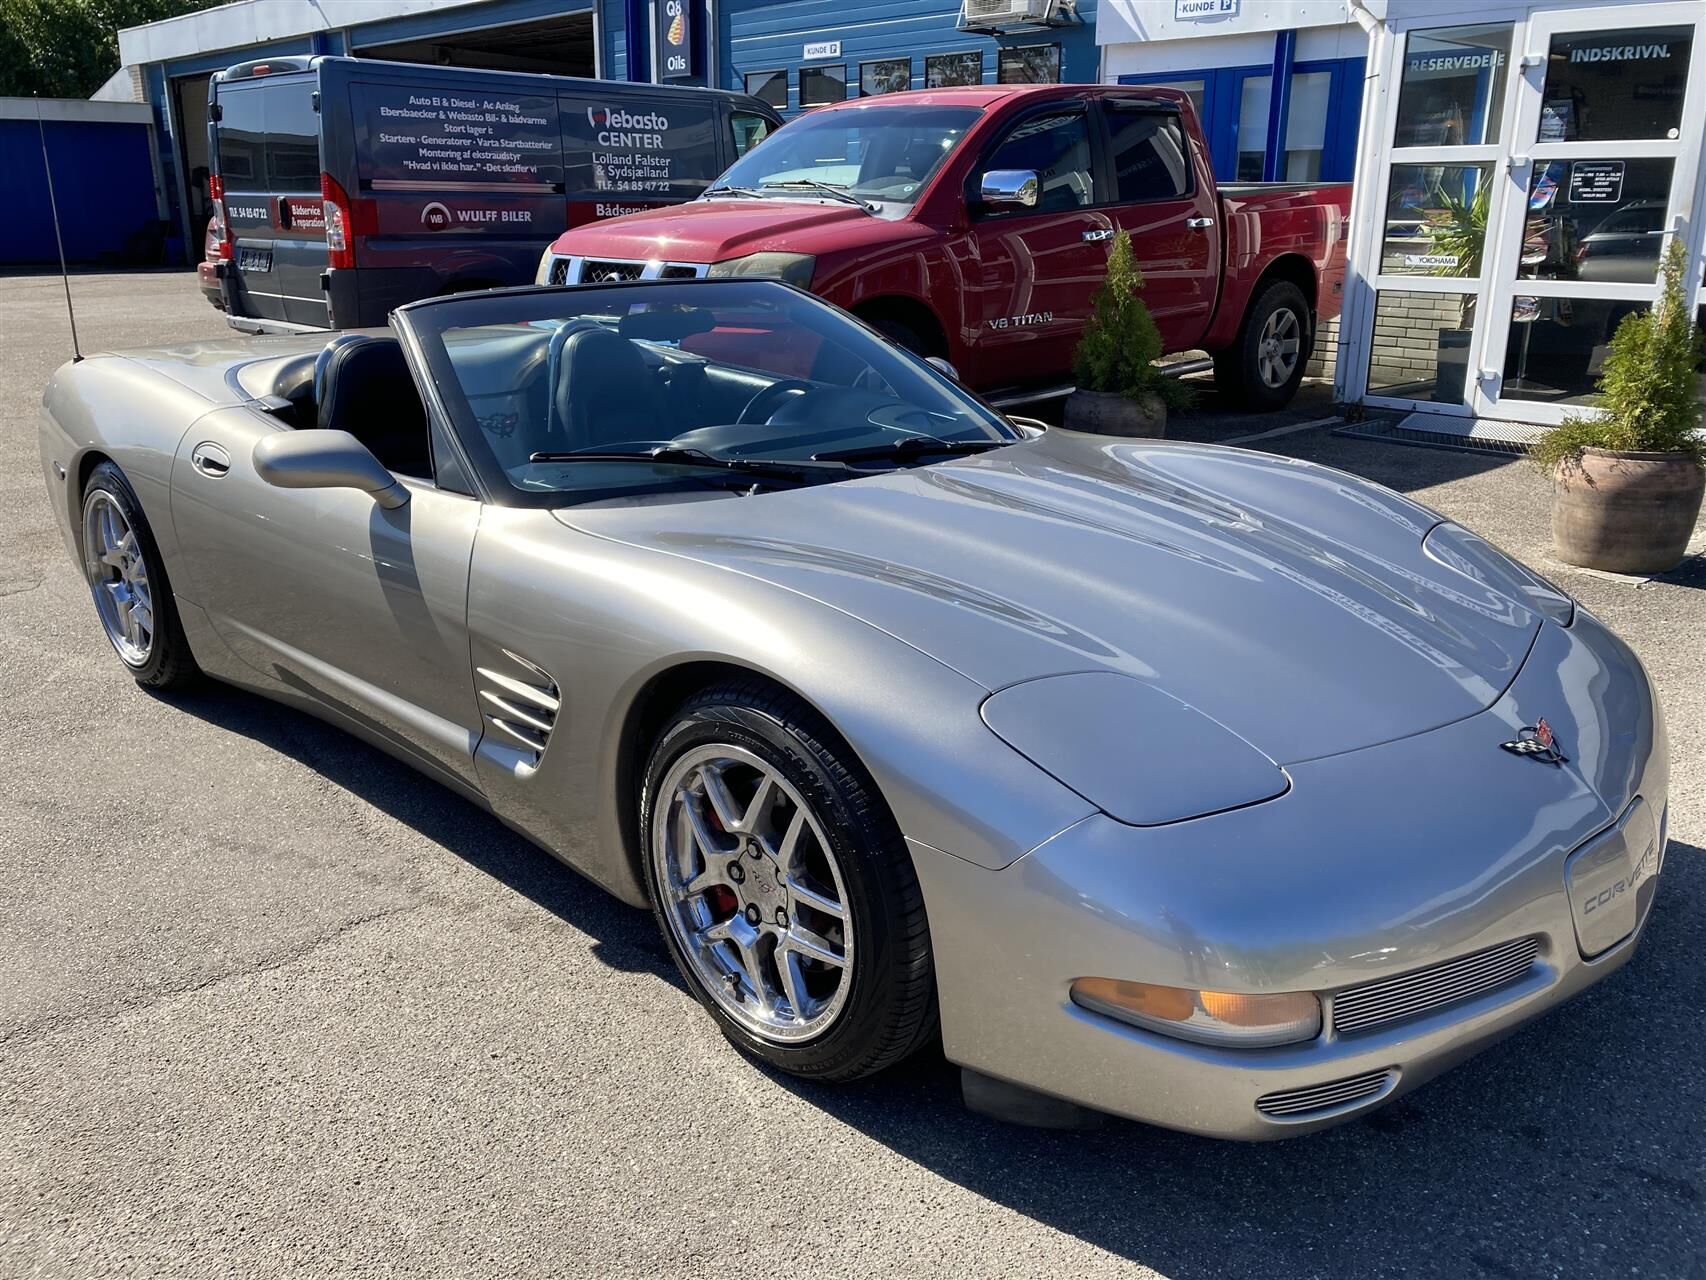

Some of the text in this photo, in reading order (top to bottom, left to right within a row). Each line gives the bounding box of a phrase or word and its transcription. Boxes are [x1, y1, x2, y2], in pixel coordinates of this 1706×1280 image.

[666, 1, 682, 17] Q8
[1182, 1, 1214, 13] KUNDE
[807, 46, 827, 55] KUNDE
[1571, 44, 1671, 63] INDSKRIVN.
[667, 57, 686, 71] Oils
[1410, 53, 1505, 72] RESERVEDELE
[409, 95, 431, 106] Auto
[442, 98, 449, 107] &
[483, 101, 494, 110] Ac
[380, 107, 547, 125] Ebersbaecker & Webasto Bil- & bådvarme
[587, 107, 668, 130] Webasto
[444, 123, 466, 134] Stort
[467, 124, 487, 136] lager
[379, 133, 552, 150] Startere Generatorer Varta Startbatterier
[597, 131, 663, 149] CENTER
[419, 148, 521, 162] Montering af ekstraudstyr
[592, 152, 671, 166] Lolland Falster
[432, 162, 440, 171] vi
[441, 162, 459, 171] ikke
[502, 164, 529, 173] skaffer
[530, 165, 537, 174] vi
[596, 165, 669, 180] & Sydsjælland
[597, 181, 670, 192] TLF. 54 85 47 22
[228, 207, 239, 217] TLF.
[291, 205, 321, 216] Bådservice
[457, 210, 532, 222] WULFF BILER
[291, 217, 325, 229] & reparation
[430, 214, 443, 224] WB
[1419, 256, 1456, 264] YOKOHAMA
[988, 311, 1053, 329] V8 TITAN
[1584, 838, 1655, 914] CORVETTE
